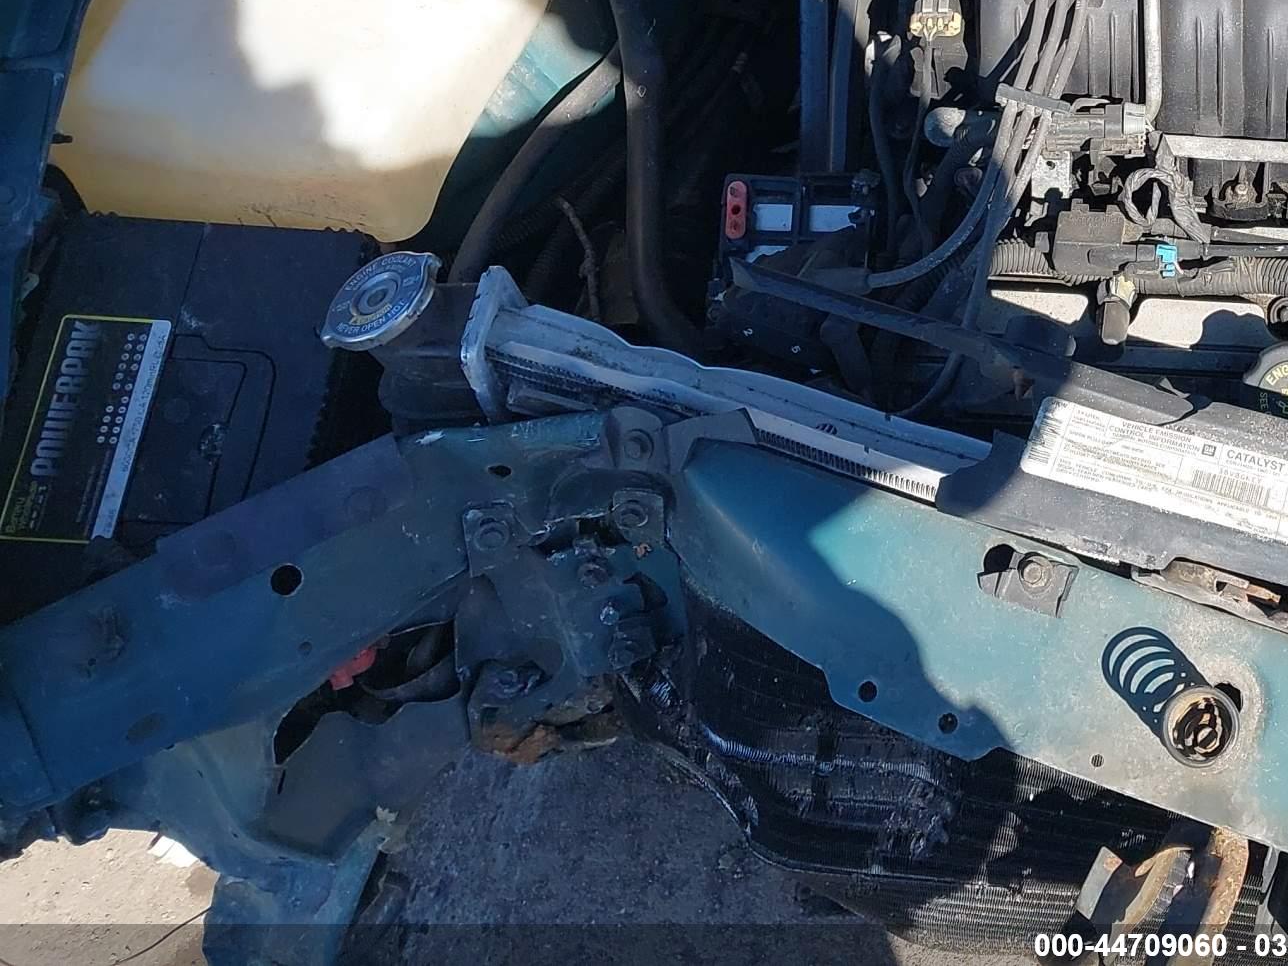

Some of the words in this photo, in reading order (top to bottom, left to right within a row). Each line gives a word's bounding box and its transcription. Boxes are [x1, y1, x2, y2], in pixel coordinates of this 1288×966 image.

[344, 262, 378, 291] ENGINE
[336, 322, 361, 335] NEVER
[361, 315, 386, 333] OPEN
[742, 328, 753, 337] 2
[1260, 392, 1269, 410] SEE
[1109, 425, 1145, 438] CONTROL
[1149, 433, 1200, 452] INFORMATION
[1122, 421, 1154, 433] VEHICLE
[1156, 429, 1191, 443] EMISSION
[1227, 449, 1286, 472] CATALYST
